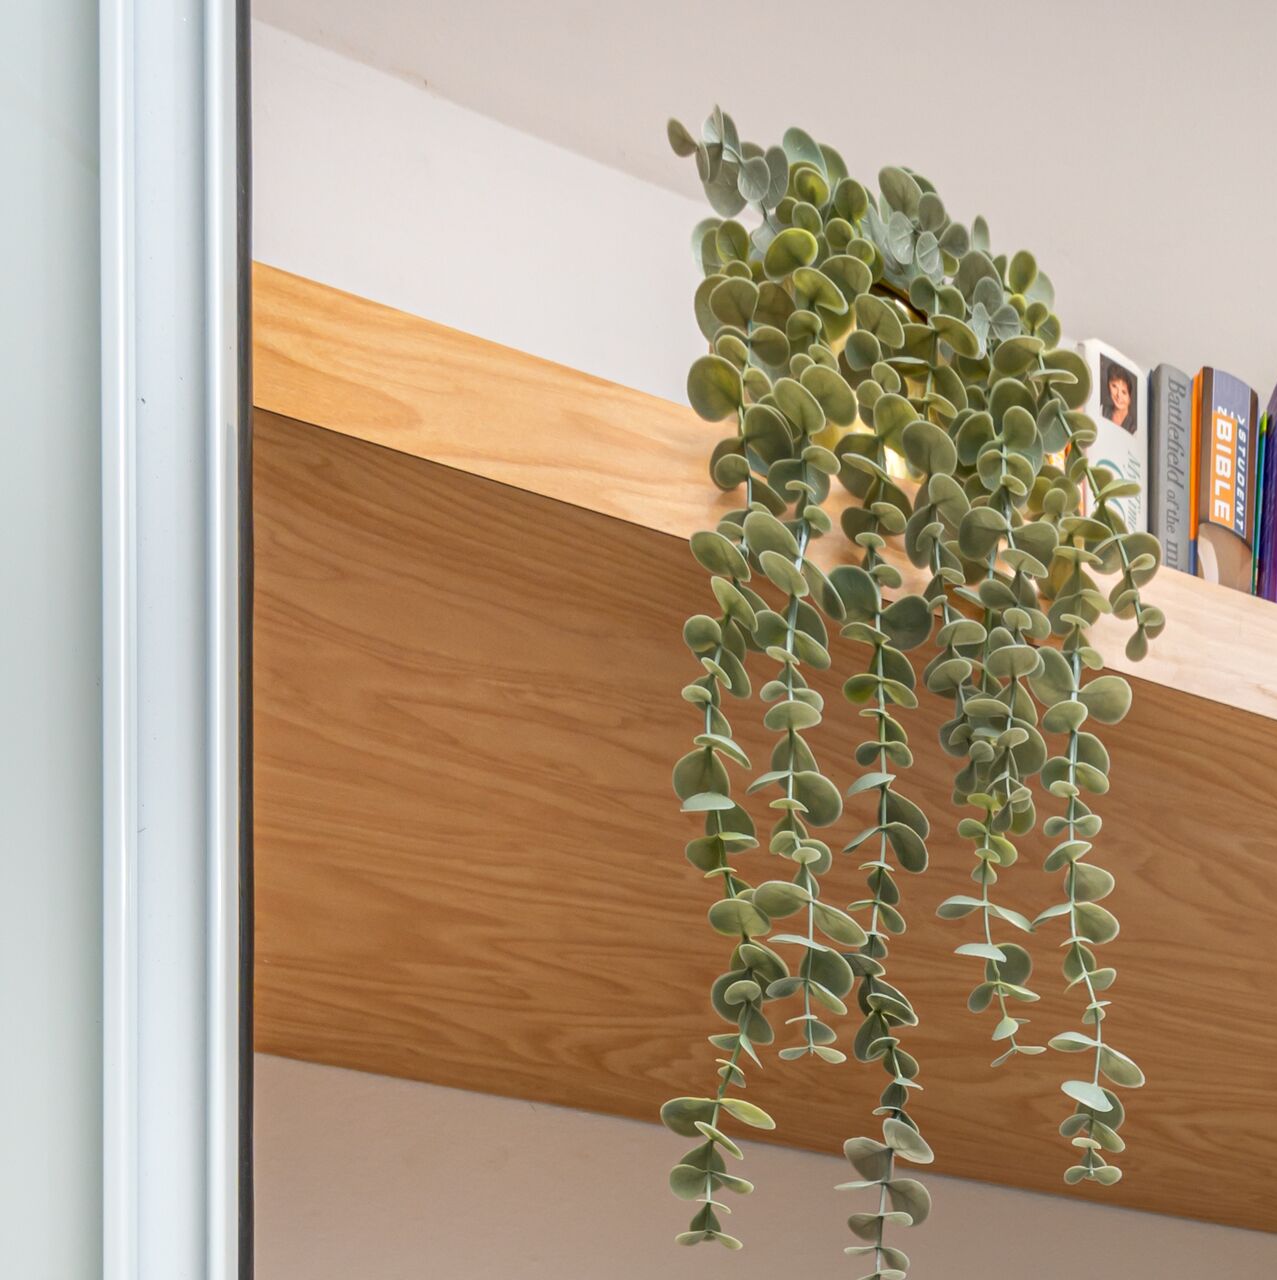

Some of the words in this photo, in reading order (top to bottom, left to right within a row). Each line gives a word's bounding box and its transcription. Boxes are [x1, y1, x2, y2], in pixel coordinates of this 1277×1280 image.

[1166, 376, 1187, 490] Battlefield
[1213, 418, 1233, 523] BIBLE
[1233, 428, 1248, 531] STUDENT
[1166, 502, 1180, 534] the
